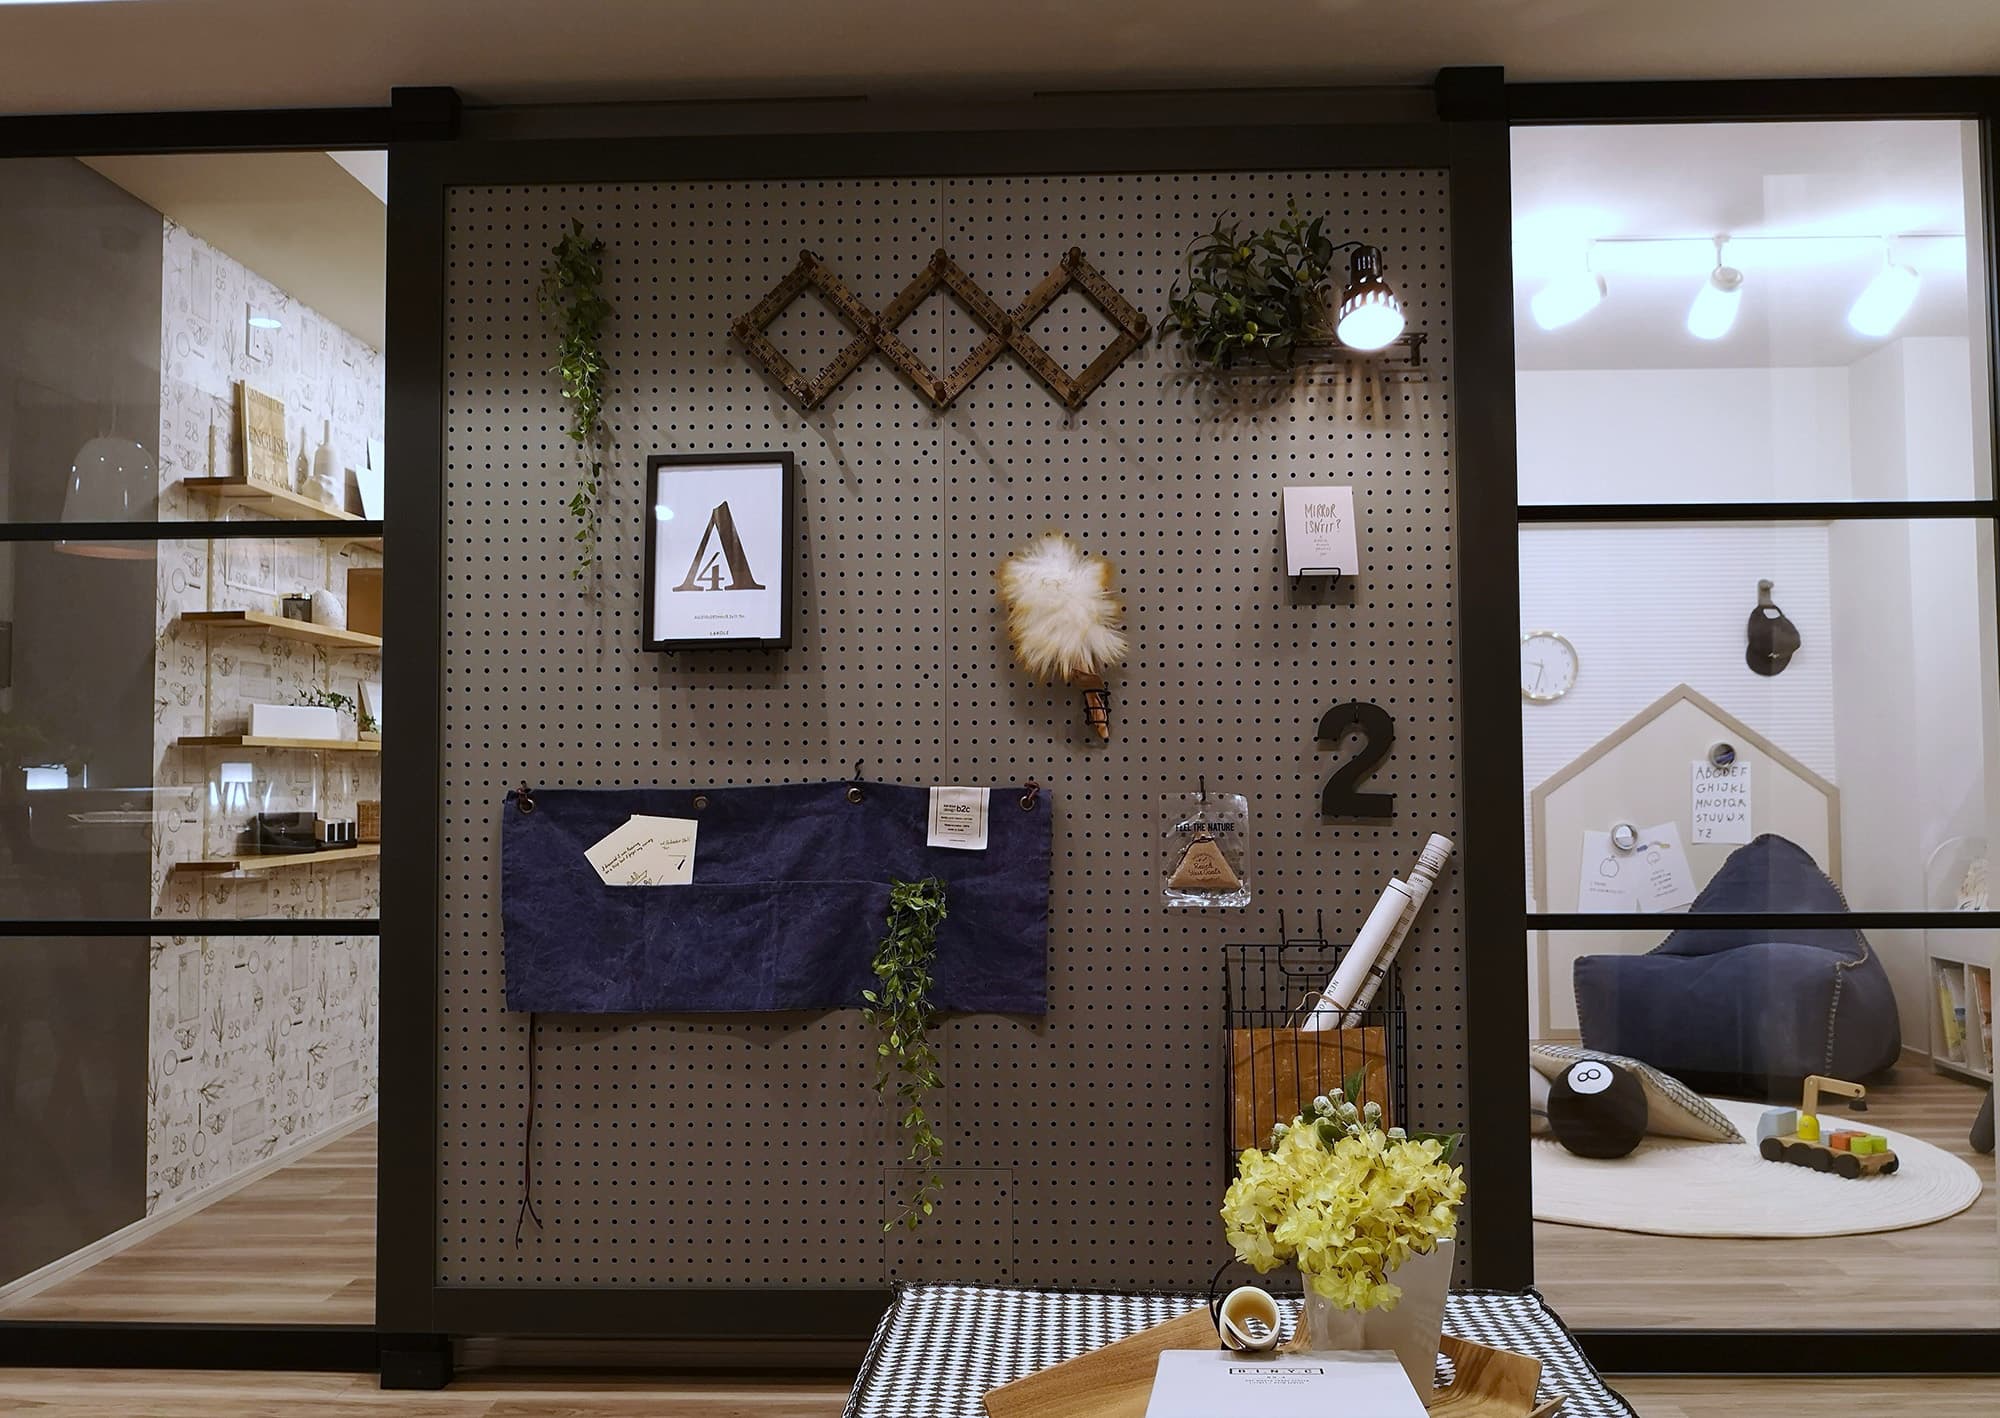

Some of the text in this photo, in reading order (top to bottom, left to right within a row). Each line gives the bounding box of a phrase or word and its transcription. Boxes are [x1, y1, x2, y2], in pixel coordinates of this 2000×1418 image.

[1304, 503, 1337, 519] MIRROR
[1317, 702, 1394, 818] 2
[956, 804, 971, 813] b2c
[1175, 822, 1235, 832] FEEL THE NATURE
[1327, 978, 1340, 996] NEW
